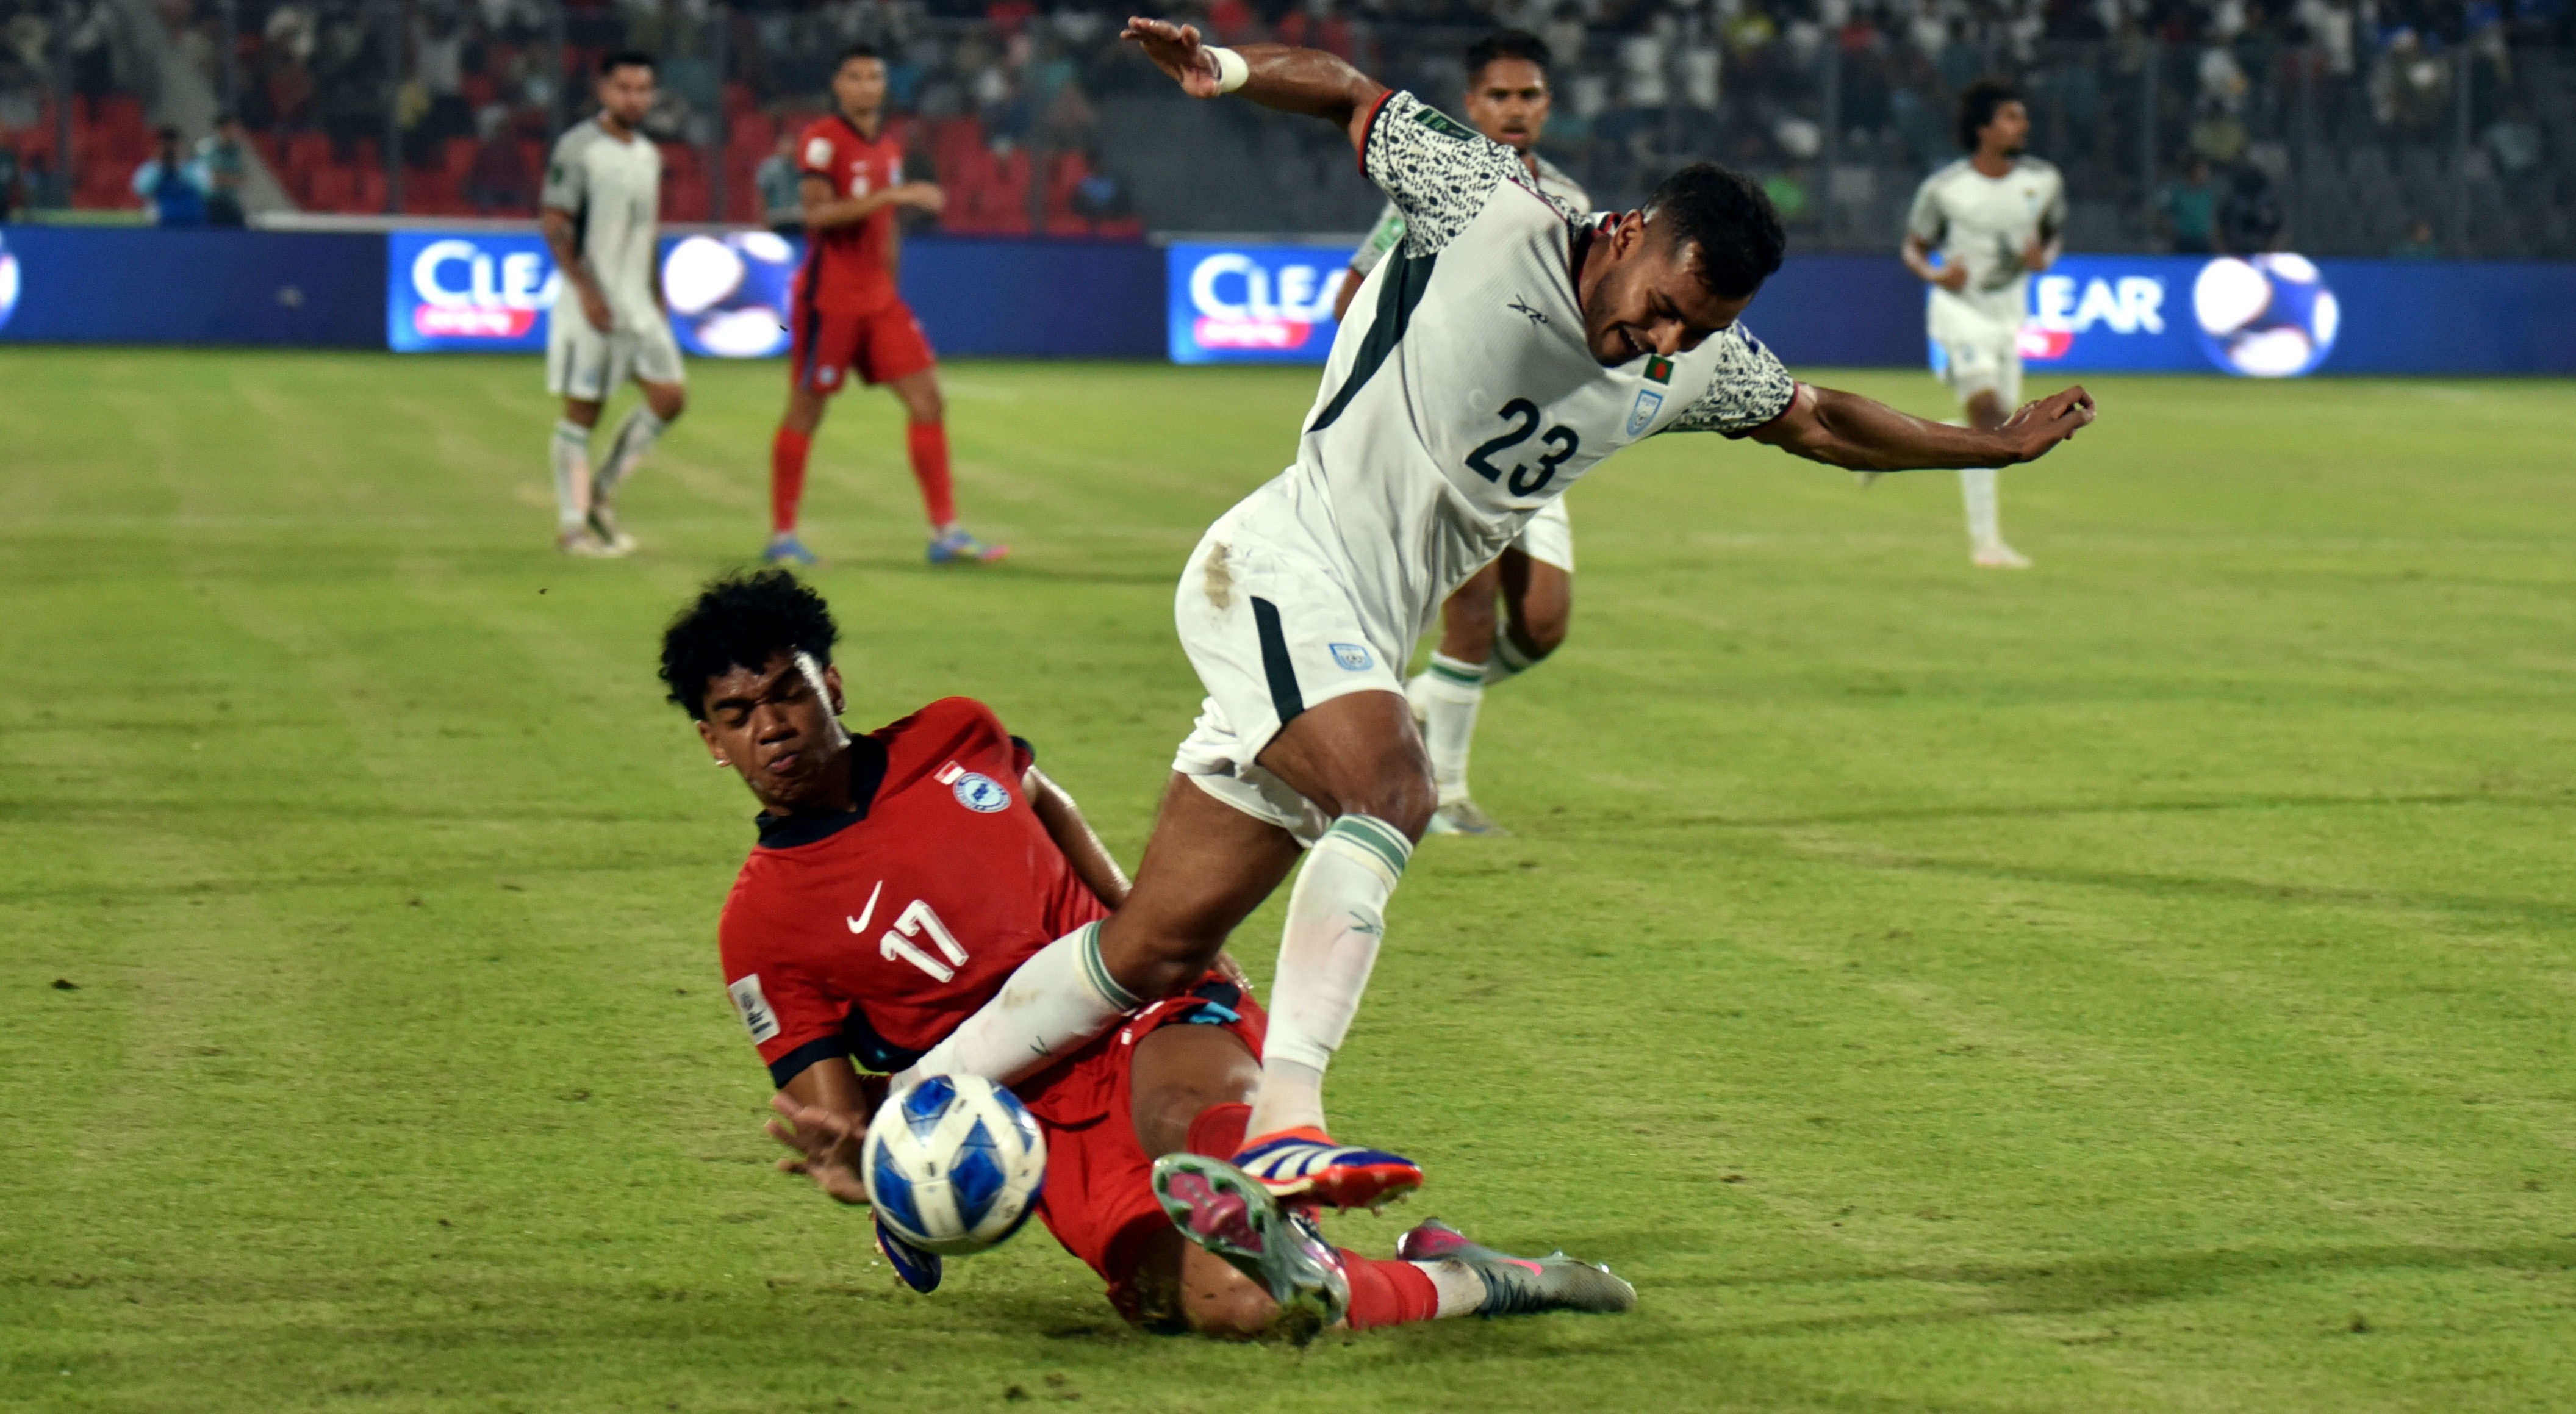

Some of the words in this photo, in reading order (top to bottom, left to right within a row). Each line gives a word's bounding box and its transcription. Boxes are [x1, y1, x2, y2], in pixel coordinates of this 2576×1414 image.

[2030, 275, 2165, 334] EAR
[1465, 398, 1579, 497] 23
[880, 899, 969, 983] 17
